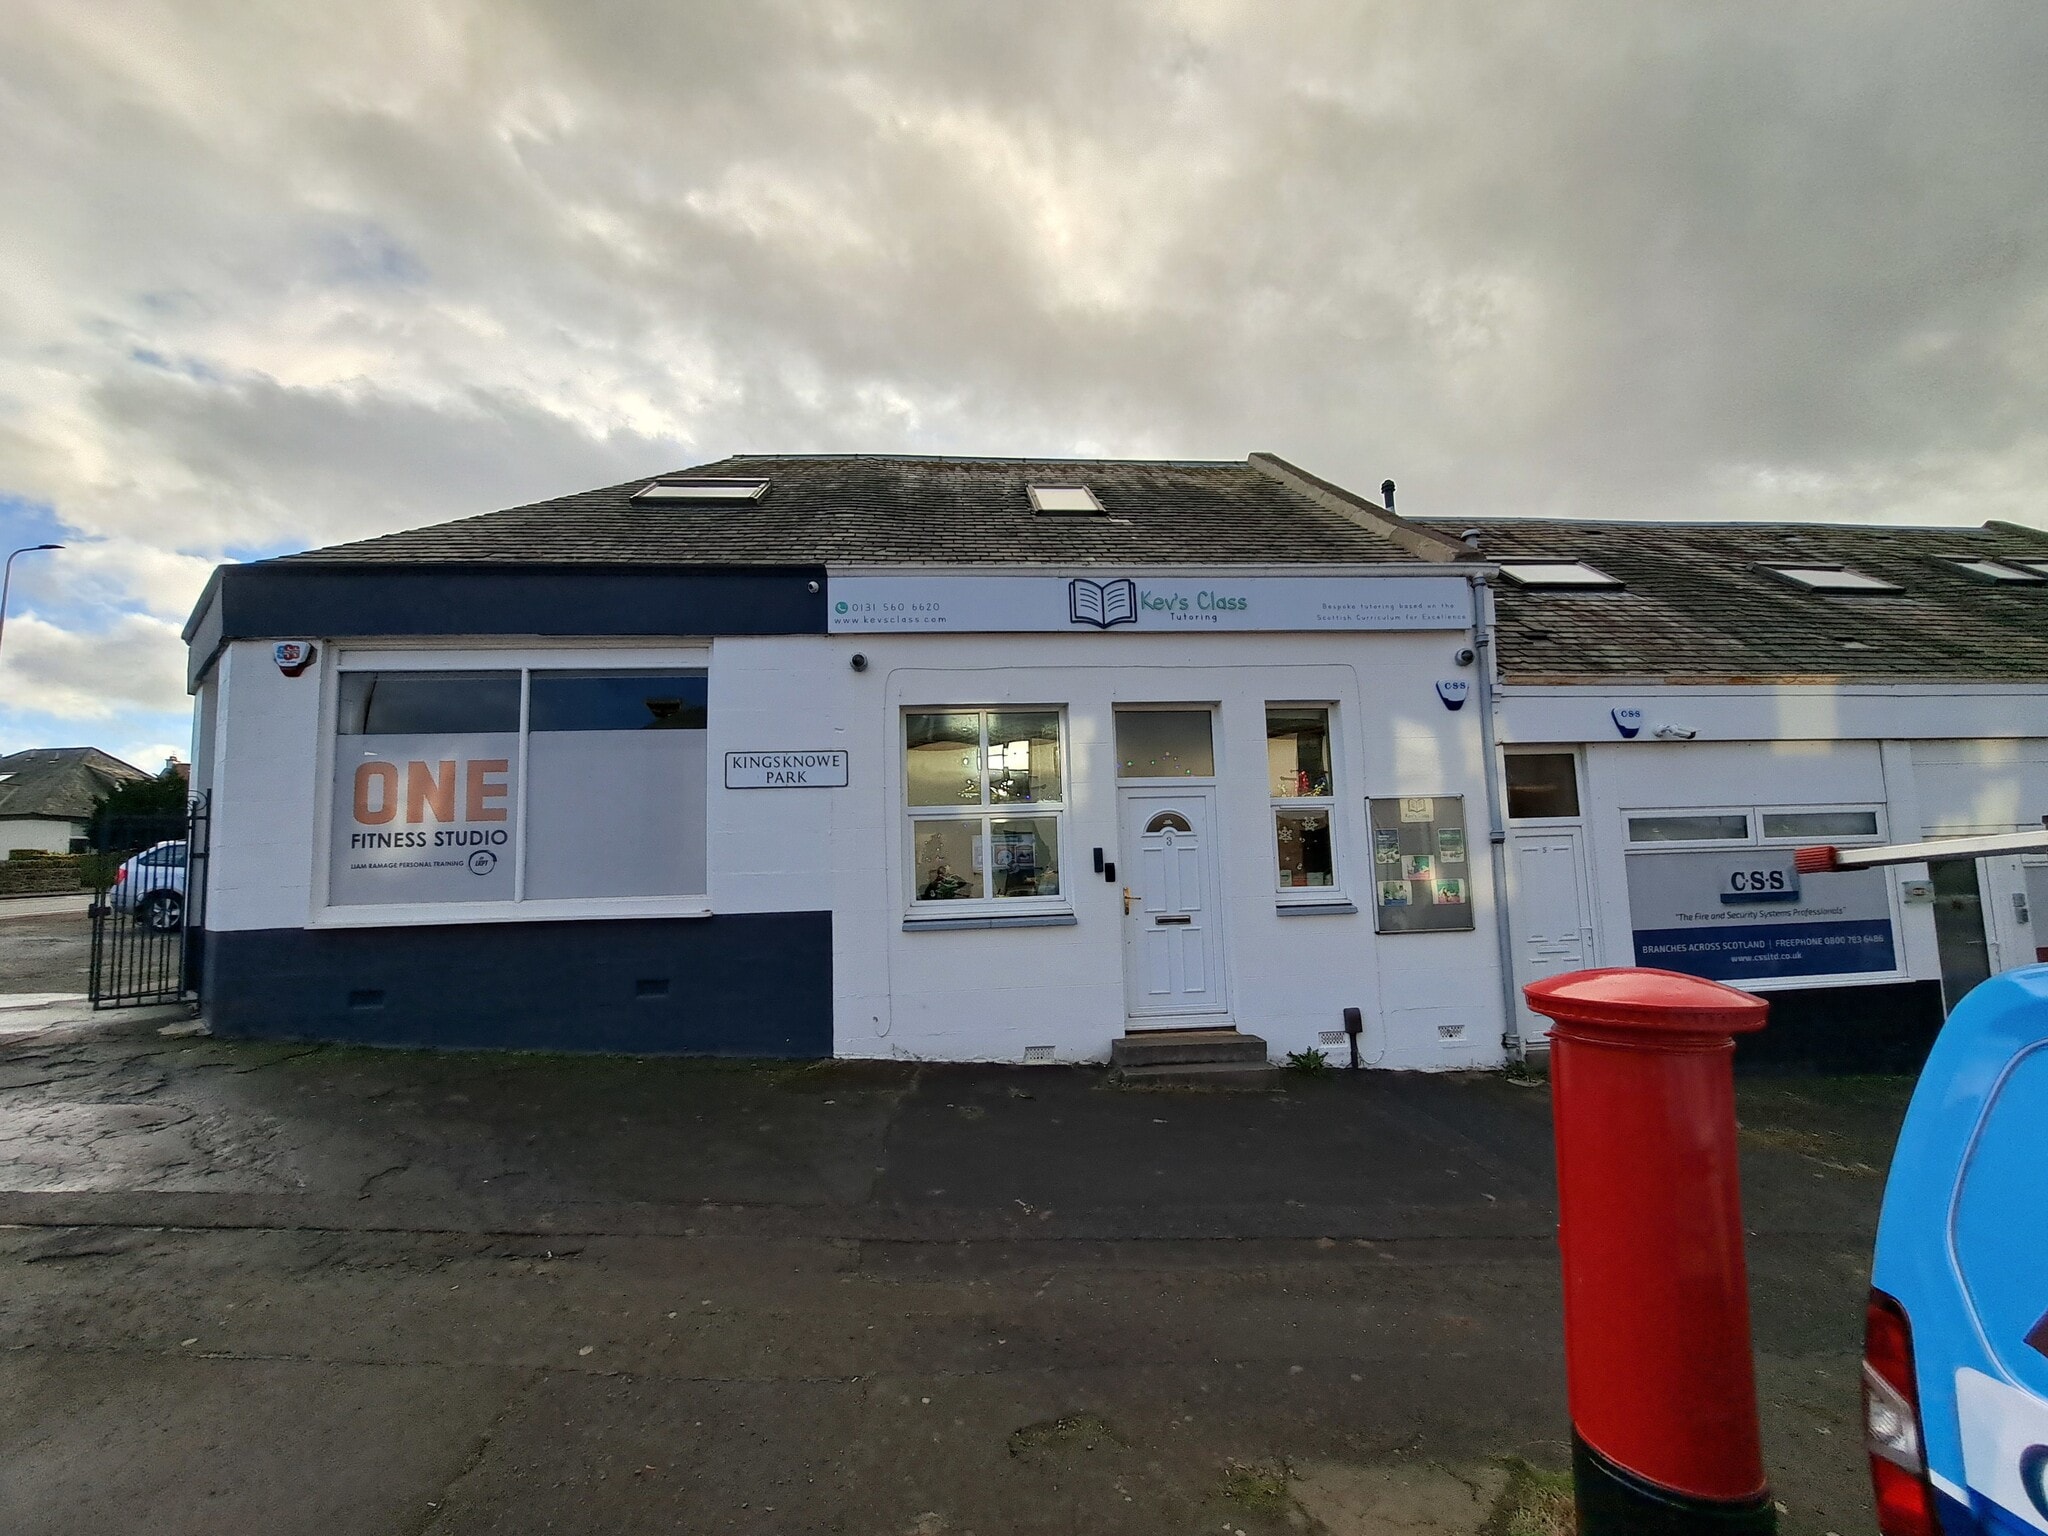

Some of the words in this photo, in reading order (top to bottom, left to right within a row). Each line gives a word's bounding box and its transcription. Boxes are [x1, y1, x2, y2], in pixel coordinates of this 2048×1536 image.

[1140, 590, 1190, 611] Kev's
[1196, 591, 1248, 611] Class
[851, 603, 877, 612] 0131
[883, 603, 905, 612] 560
[911, 603, 940, 612] 6620
[834, 615, 947, 625] wwwkevsclasscom
[1170, 612, 1218, 623] Tutoring
[732, 755, 840, 769] KINGSKNOWE
[766, 771, 808, 784] PARK
[353, 758, 509, 825] ONE
[351, 832, 427, 849] FITNESS
[434, 829, 509, 847] STUDIO
[1166, 836, 1173, 847] 3
[1694, 912, 1709, 920] Fire
[1711, 912, 1725, 920] and
[1726, 911, 1758, 920] Security
[1759, 909, 1792, 919] Systems
[1642, 943, 1687, 954] BRANCHES
[1688, 942, 1721, 952] ACROSS
[1722, 940, 1765, 950] SCOTLAND
[1775, 937, 1823, 947] FREEPHONE
[1824, 936, 1846, 945] 0800
[1730, 951, 1802, 963] www.cssltd.co.uk
